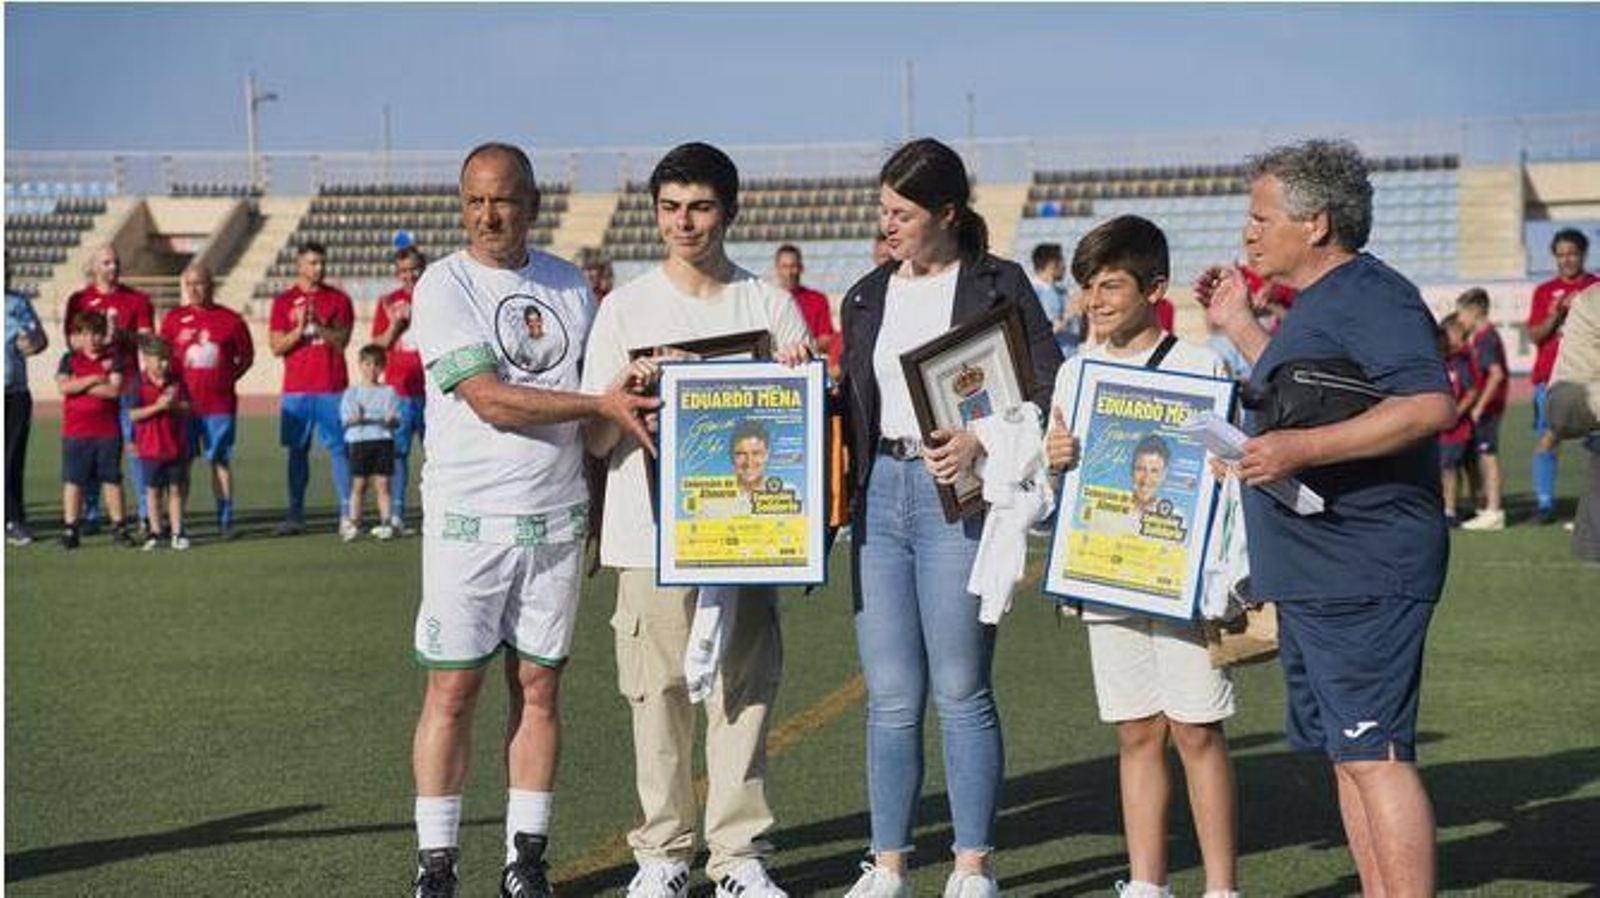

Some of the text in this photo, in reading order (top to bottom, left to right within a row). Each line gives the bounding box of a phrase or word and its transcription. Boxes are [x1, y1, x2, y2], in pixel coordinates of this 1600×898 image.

[682, 388, 802, 409] EDUARDO MENA
[1097, 396, 1164, 421] EDUARDO
